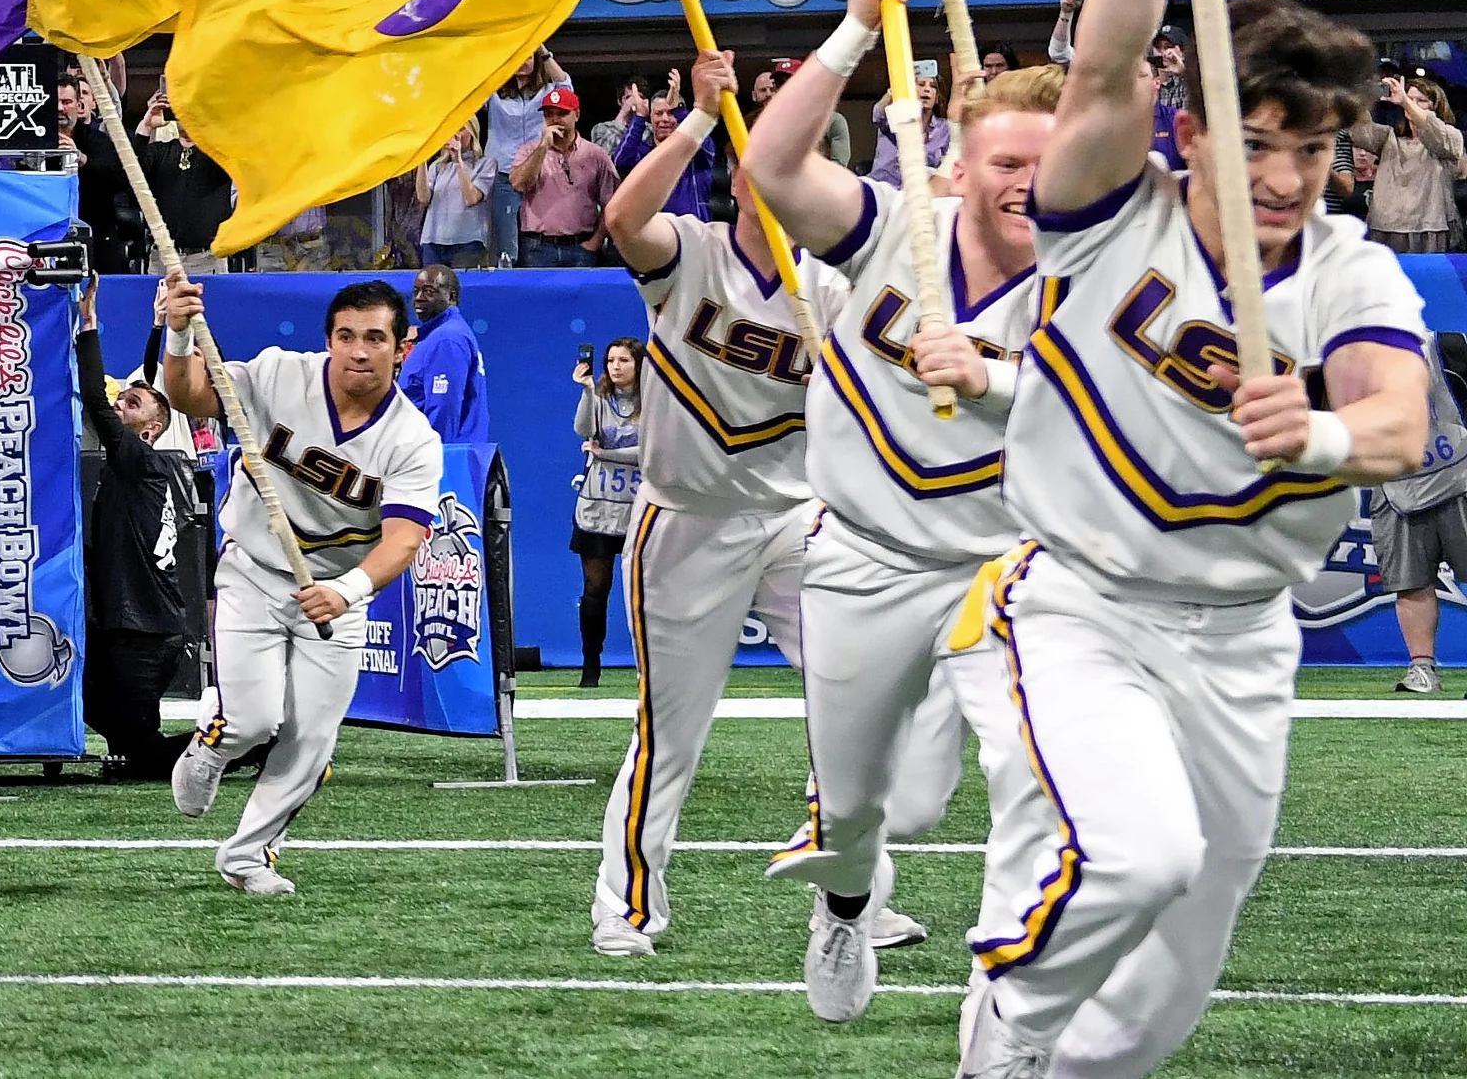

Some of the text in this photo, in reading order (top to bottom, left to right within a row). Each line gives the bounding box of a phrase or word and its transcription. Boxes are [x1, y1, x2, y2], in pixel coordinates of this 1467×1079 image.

[261, 422, 382, 511] LSU
[598, 468, 642, 495] 155
[416, 587, 477, 629] PEACH
